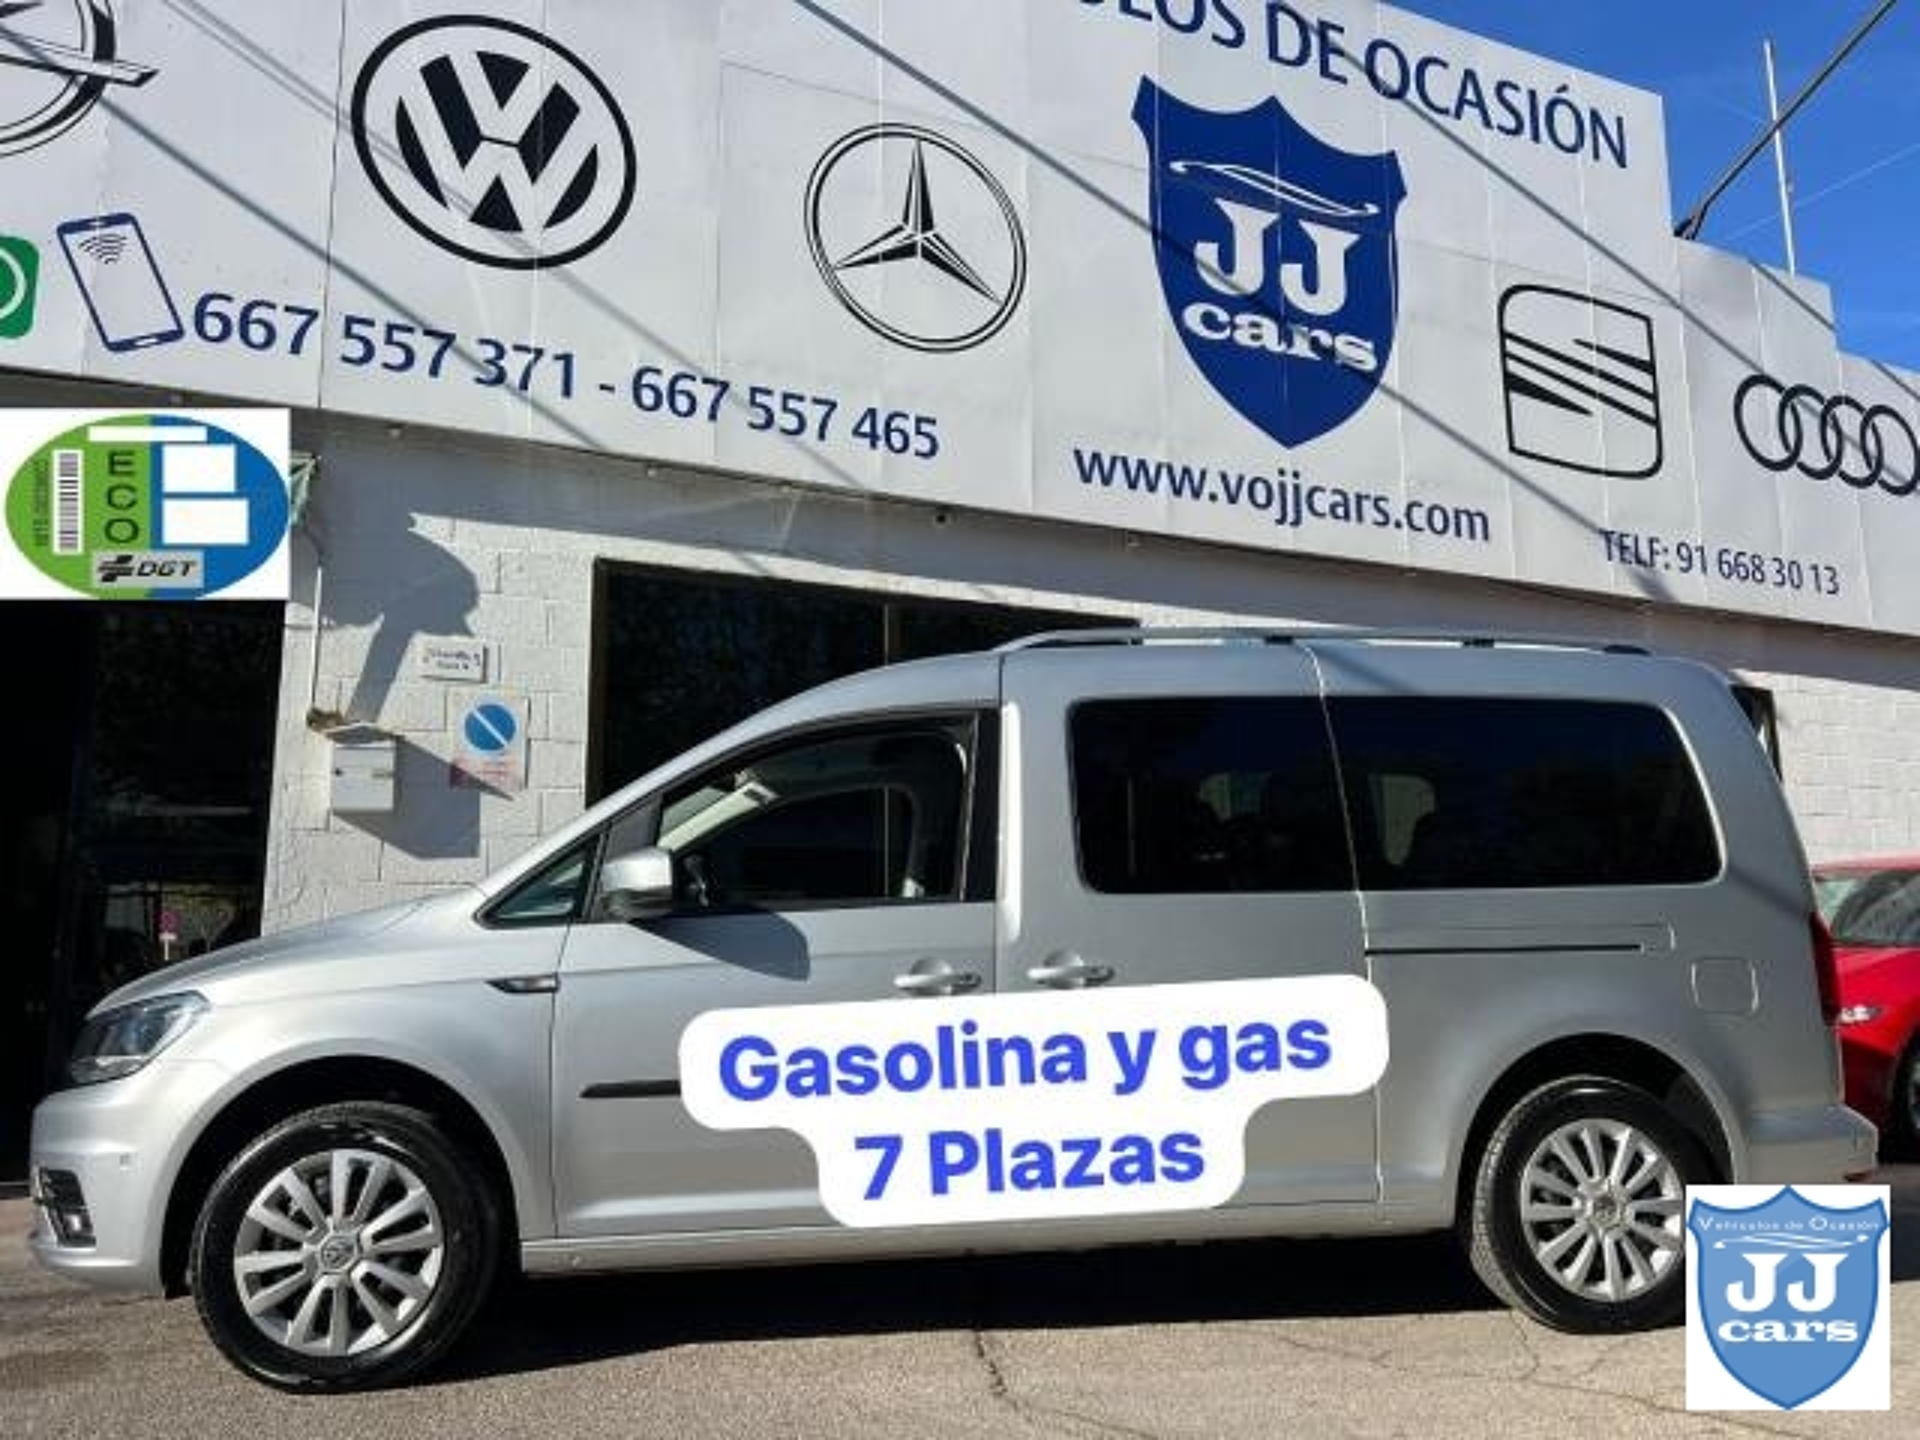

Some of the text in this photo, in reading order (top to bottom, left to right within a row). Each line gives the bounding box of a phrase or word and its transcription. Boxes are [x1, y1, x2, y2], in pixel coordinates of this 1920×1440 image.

[1266, 1, 1348, 85] DE
[1364, 38, 1628, 169] OCASIÓN
[1193, 197, 1361, 316] JJ
[194, 292, 319, 355] 667
[341, 315, 457, 378] 557
[474, 338, 575, 399] 371
[631, 366, 730, 422] 667
[747, 386, 838, 441] 557
[852, 407, 940, 459] 465
[1182, 302, 1378, 372] cars
[1073, 447, 1491, 542] www.vojjcars.com
[1676, 542, 1708, 576] 91
[1717, 548, 1766, 584] 668
[1772, 557, 1803, 590] 30
[1810, 563, 1840, 595] 13
